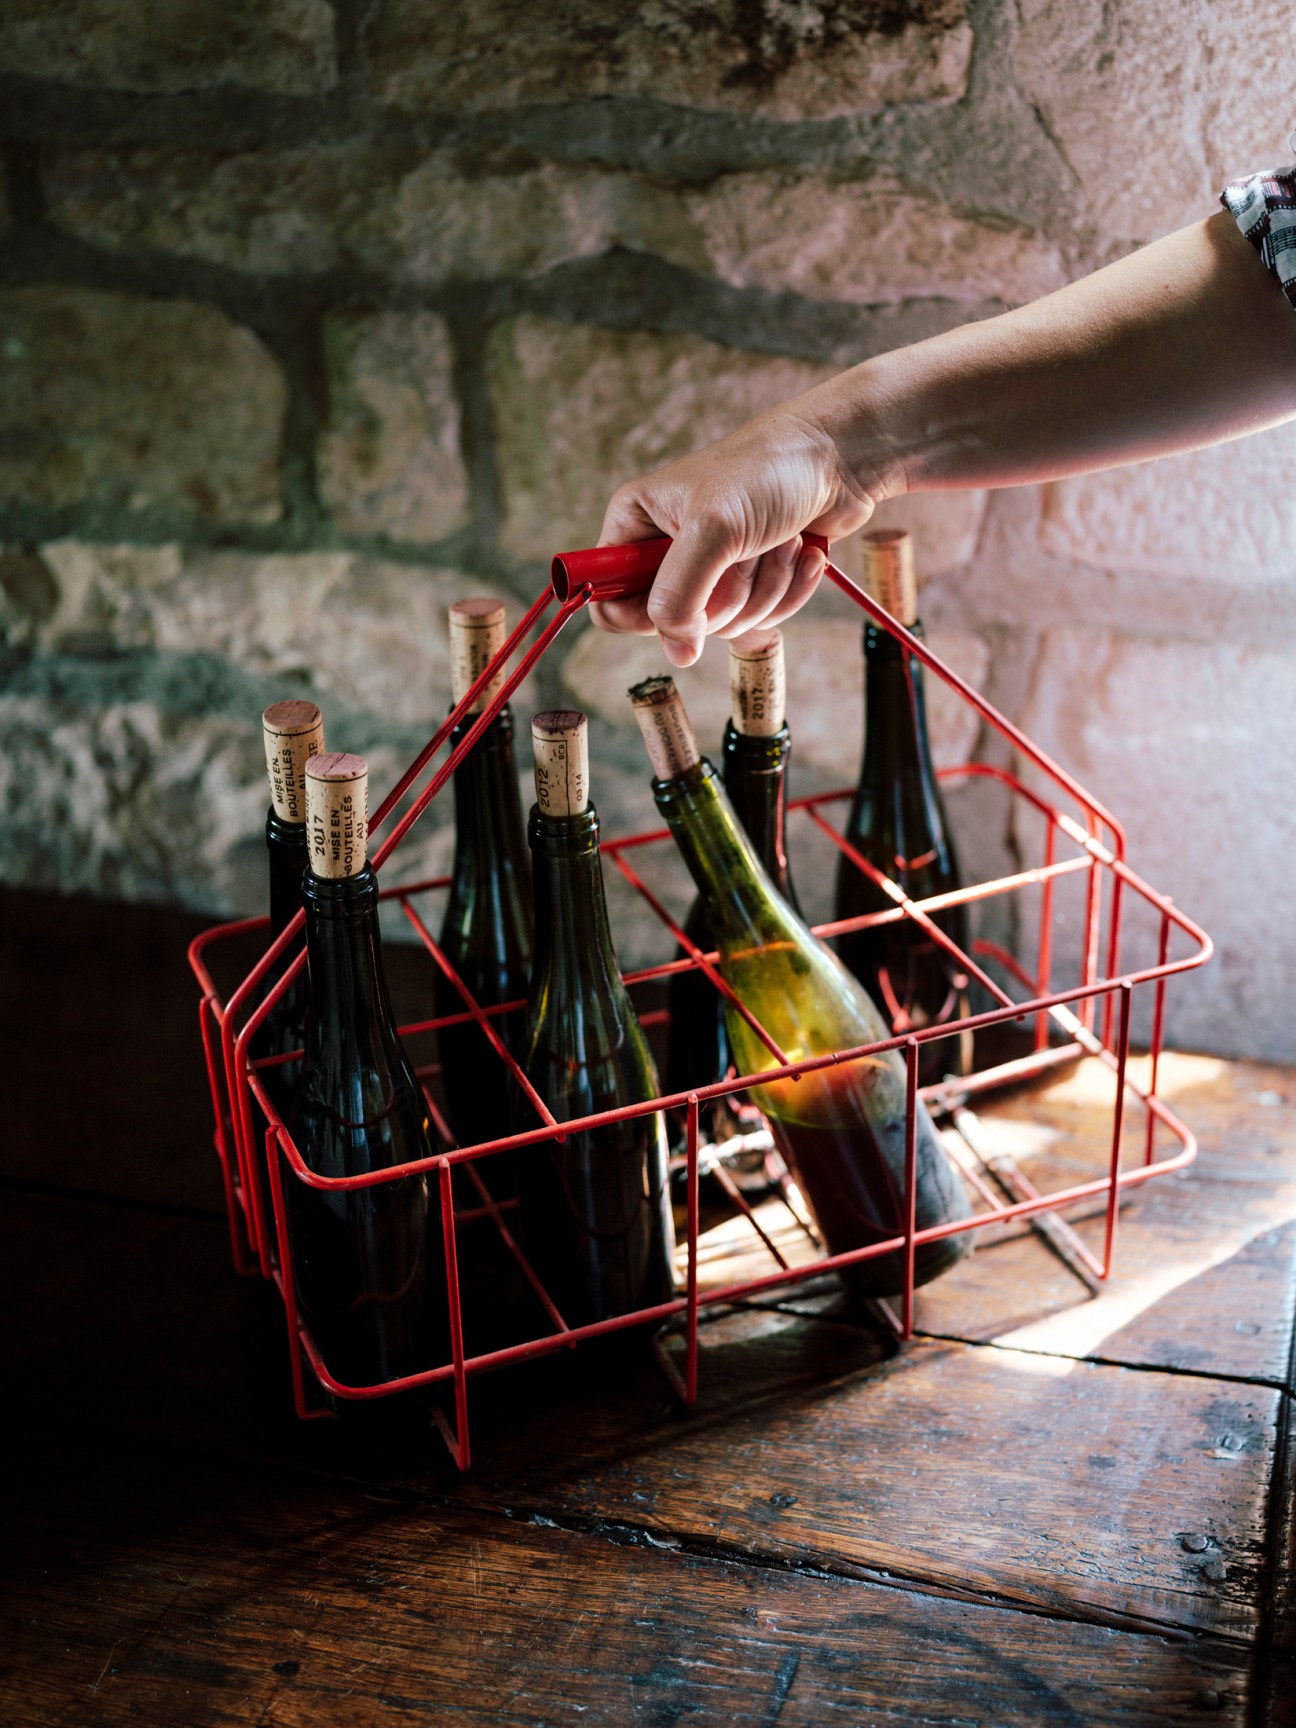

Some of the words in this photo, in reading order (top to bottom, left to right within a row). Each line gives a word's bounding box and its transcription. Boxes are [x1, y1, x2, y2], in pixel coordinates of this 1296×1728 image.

[272, 757, 281, 774] EN
[273, 776, 284, 804] MISE
[282, 749, 298, 817] BOUTEILLES
[537, 768, 550, 808] 2012
[330, 809, 340, 827] EN
[343, 795, 353, 872] BOUTEILLES
[356, 822, 364, 840] AU
[313, 815, 325, 857] 2017
[331, 830, 341, 861] MISE
